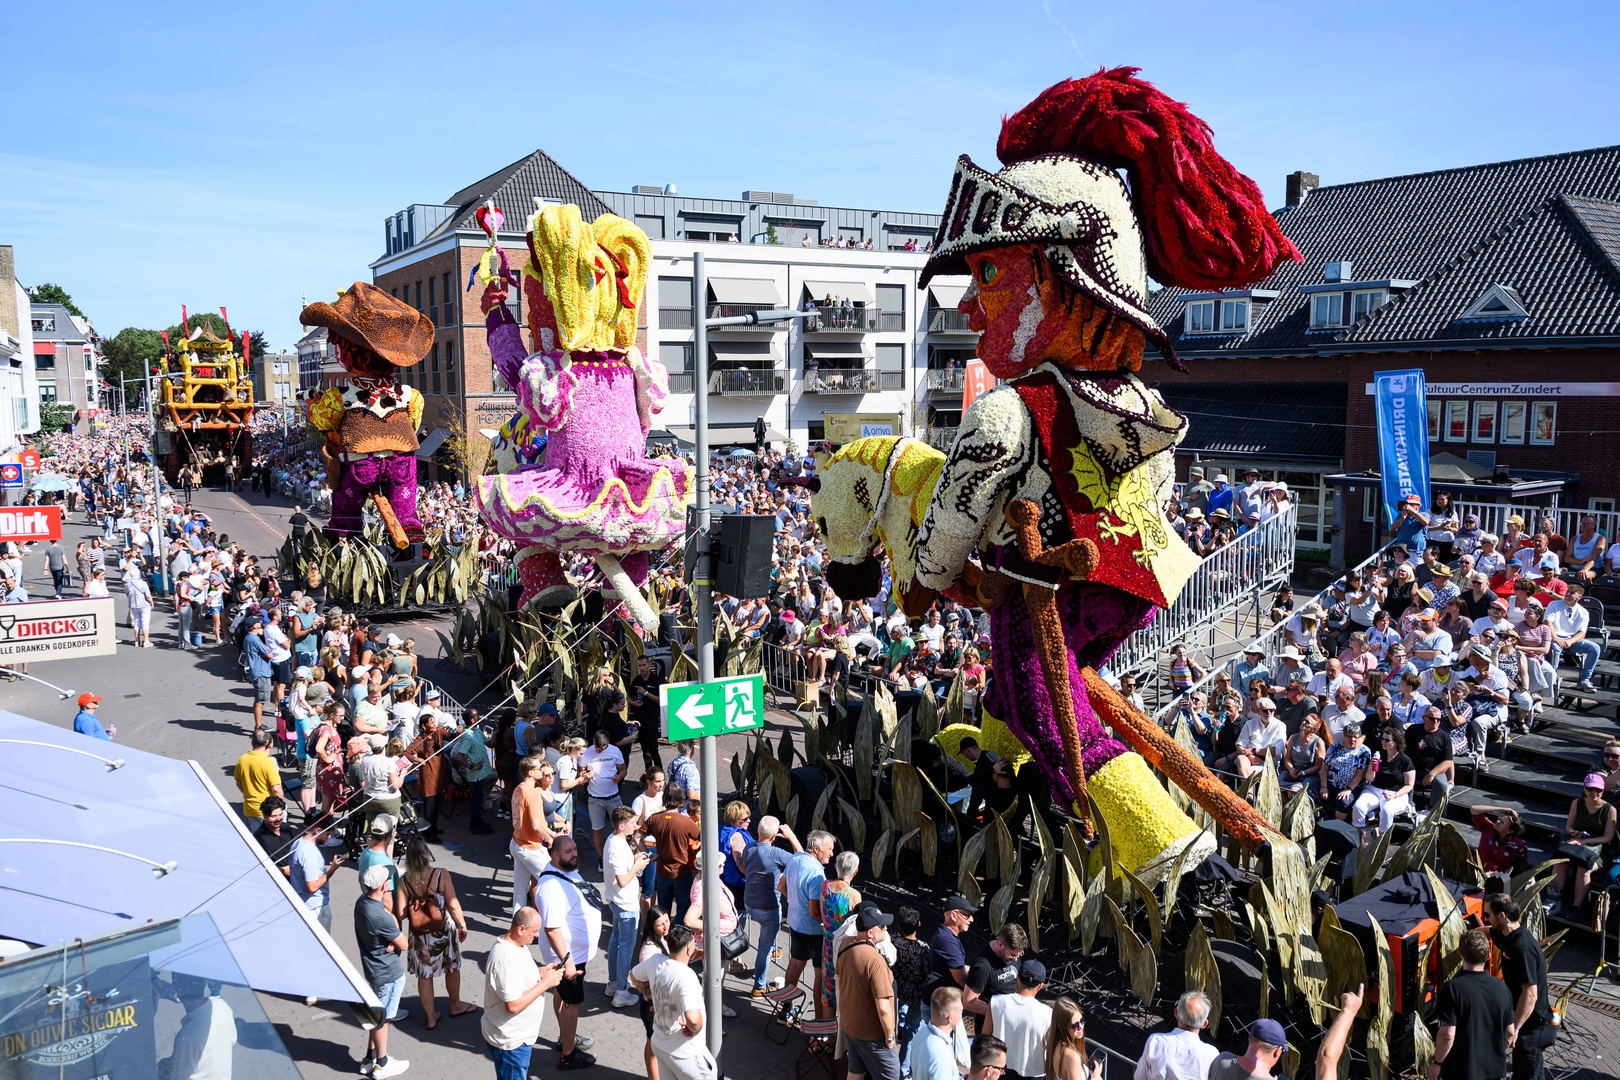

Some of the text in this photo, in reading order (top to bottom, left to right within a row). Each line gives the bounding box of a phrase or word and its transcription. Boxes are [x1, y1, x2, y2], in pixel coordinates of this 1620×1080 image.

[1424, 384, 1562, 394] ultuurCentrumZundert
[871, 427, 891, 436] arriva
[0, 511, 50, 534] Dirk
[17, 619, 78, 638] DIRCK
[0, 639, 99, 655] LLE DRANKEN GOEDKOPER!
[30, 1020, 77, 1048] OUWE
